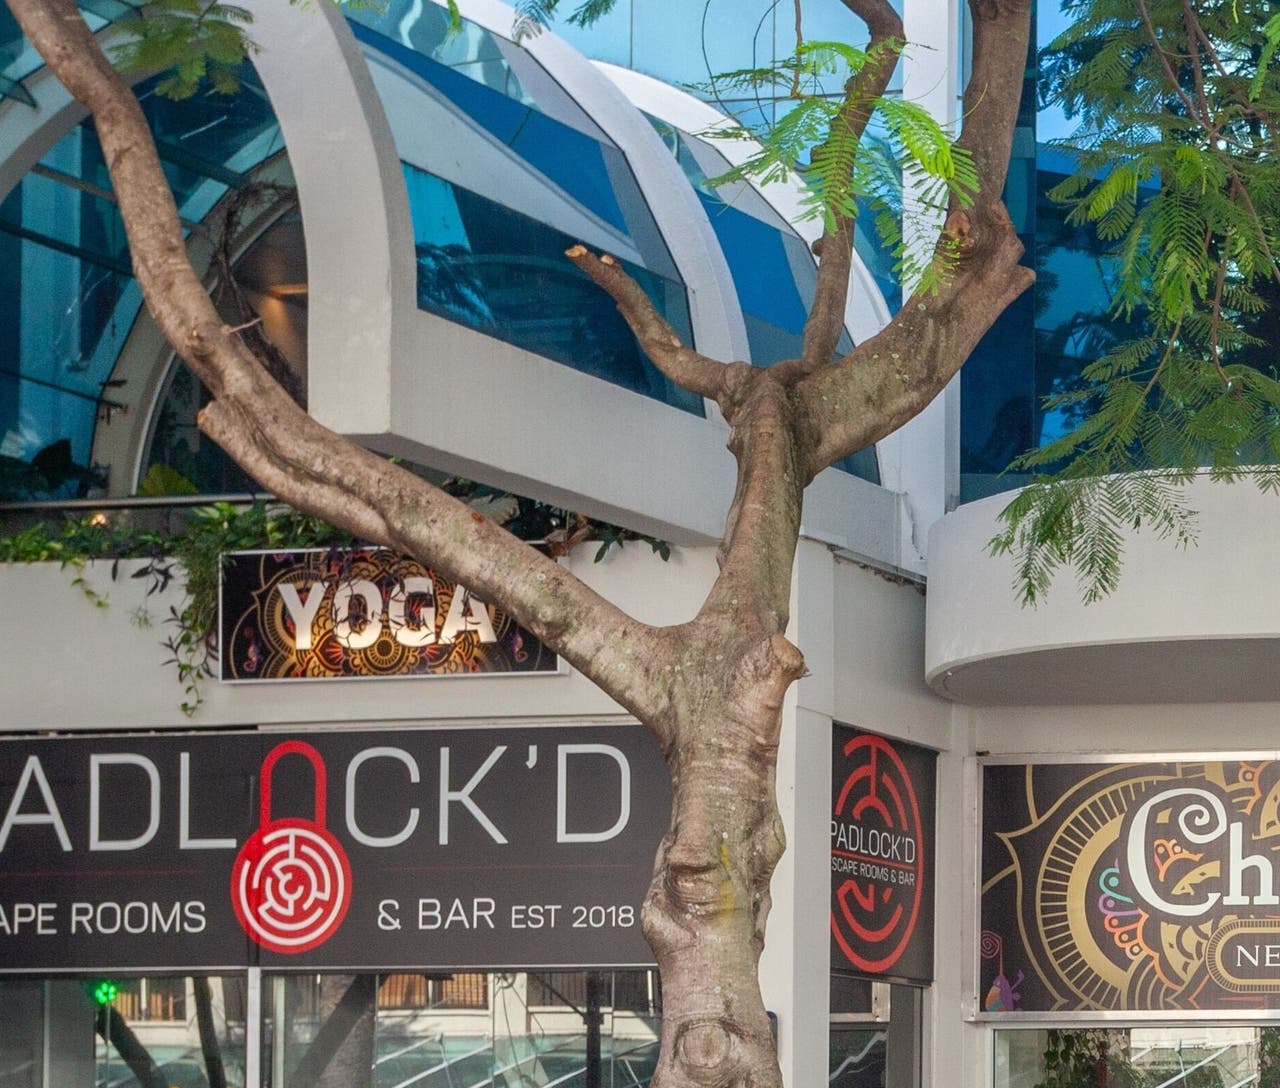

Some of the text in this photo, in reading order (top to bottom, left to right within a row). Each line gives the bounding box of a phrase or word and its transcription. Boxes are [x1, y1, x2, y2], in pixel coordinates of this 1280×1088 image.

[278, 577, 498, 651] YOGA
[860, 862, 889, 882] ROOMS
[898, 871, 915, 887] BAR
[71, 901, 207, 935] ROOMS
[378, 897, 635, 931] & BAR EST 2018
